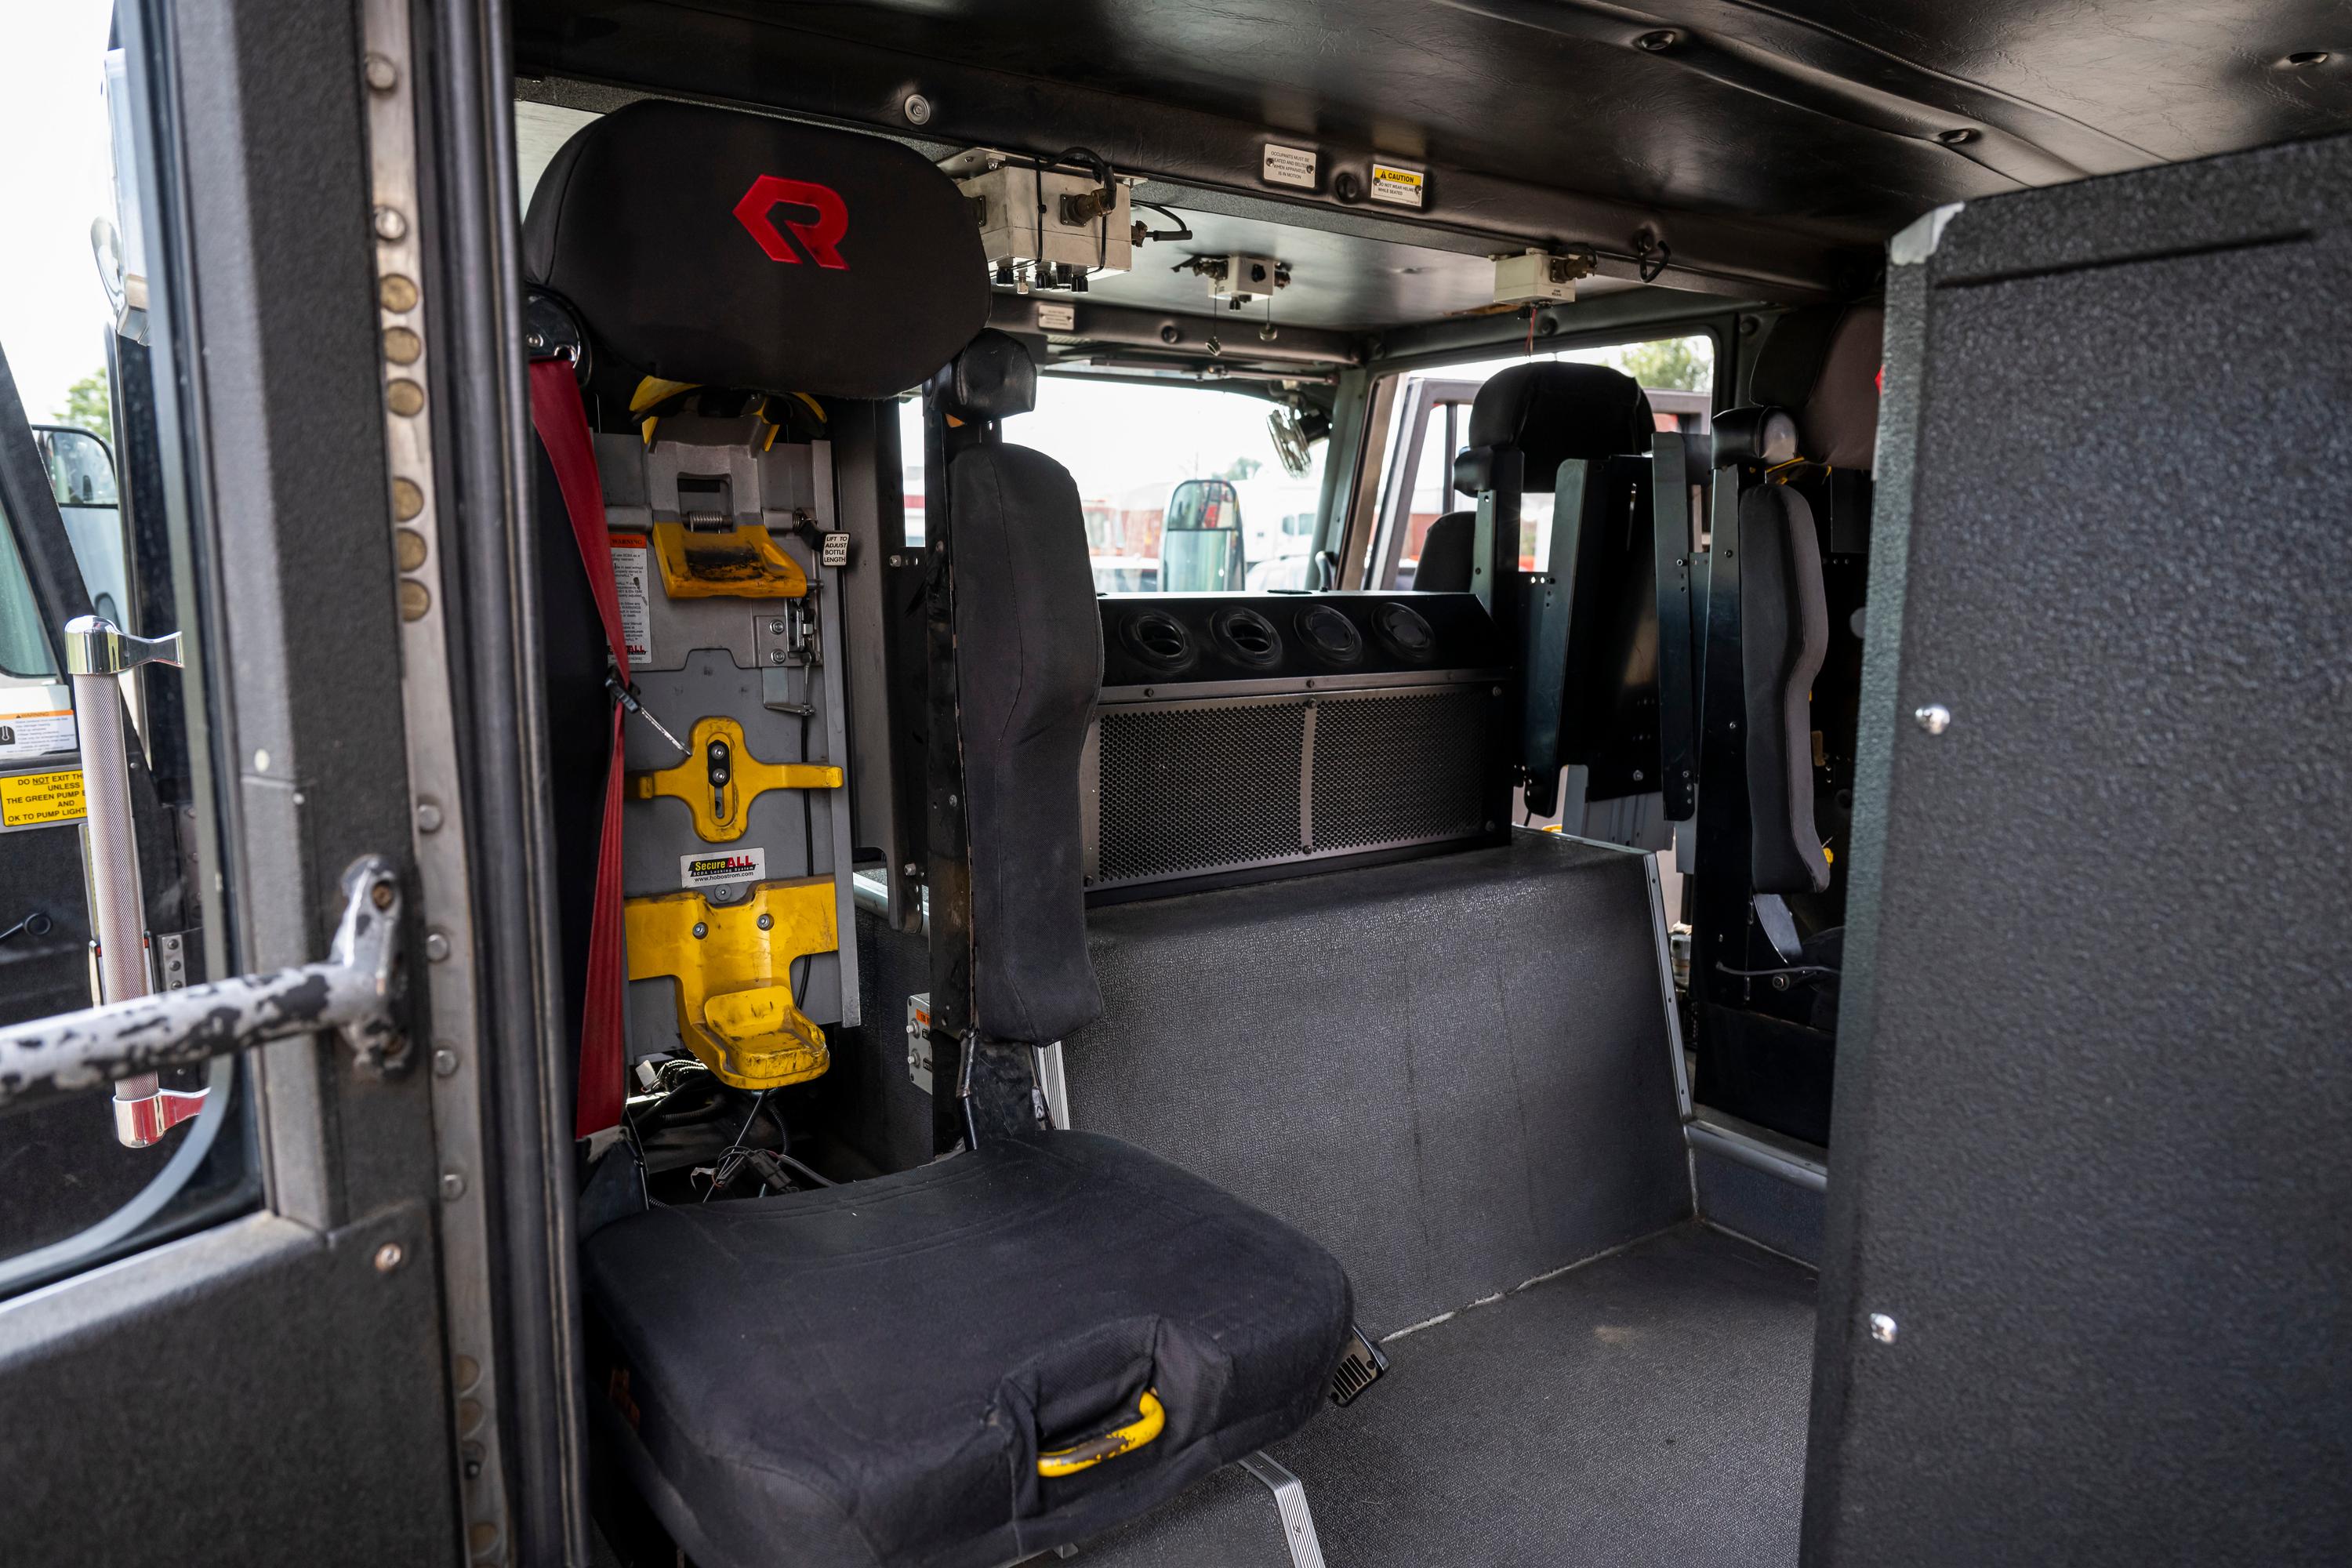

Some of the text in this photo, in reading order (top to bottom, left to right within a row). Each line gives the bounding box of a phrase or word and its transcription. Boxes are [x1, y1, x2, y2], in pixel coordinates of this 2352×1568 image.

[1388, 172, 1414, 183] CAUTION
[32, 776, 49, 785] NOT
[52, 774, 70, 782] EXIT
[48, 782, 81, 791] UNLESS
[25, 793, 55, 803] GREEN
[56, 790, 80, 799] PUMP
[37, 810, 60, 818] PUMP
[63, 807, 87, 816] LIGHT
[694, 872, 754, 882] www.hobostrom.com
